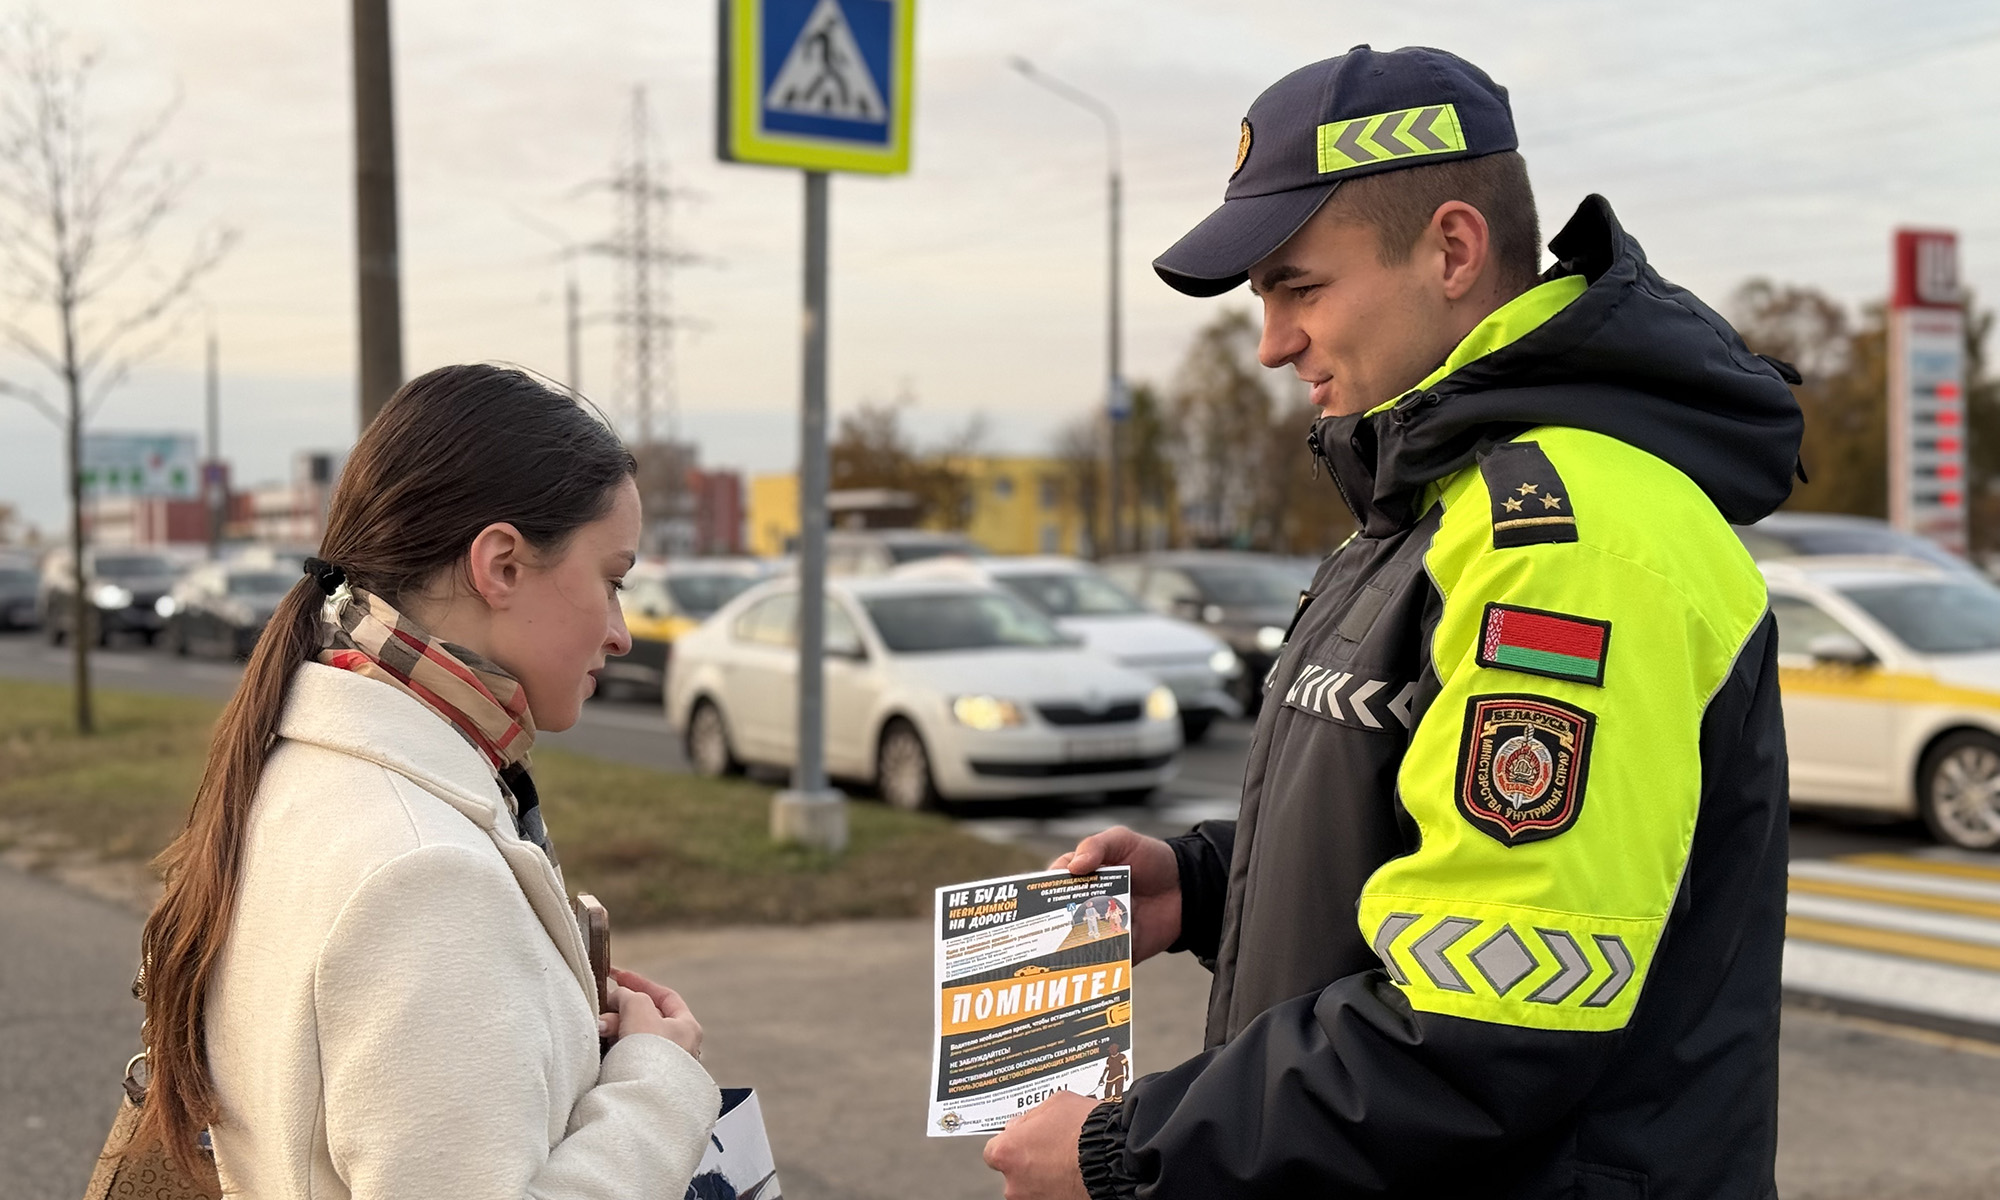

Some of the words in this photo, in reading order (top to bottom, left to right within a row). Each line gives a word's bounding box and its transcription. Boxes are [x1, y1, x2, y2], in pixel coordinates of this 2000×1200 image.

[1494, 709, 1569, 732] БЕЛАРУСЬ
[1554, 750, 1570, 786] СПРАЎ
[949, 891, 970, 908] НЕ
[974, 884, 1019, 904] БУДЬ
[949, 898, 1018, 919] НЕВИДИМКОЙ
[949, 918, 966, 931] НА
[968, 910, 1018, 930] ДОРОГЕ!
[951, 967, 1123, 1025] ПОМНИТЕ!
